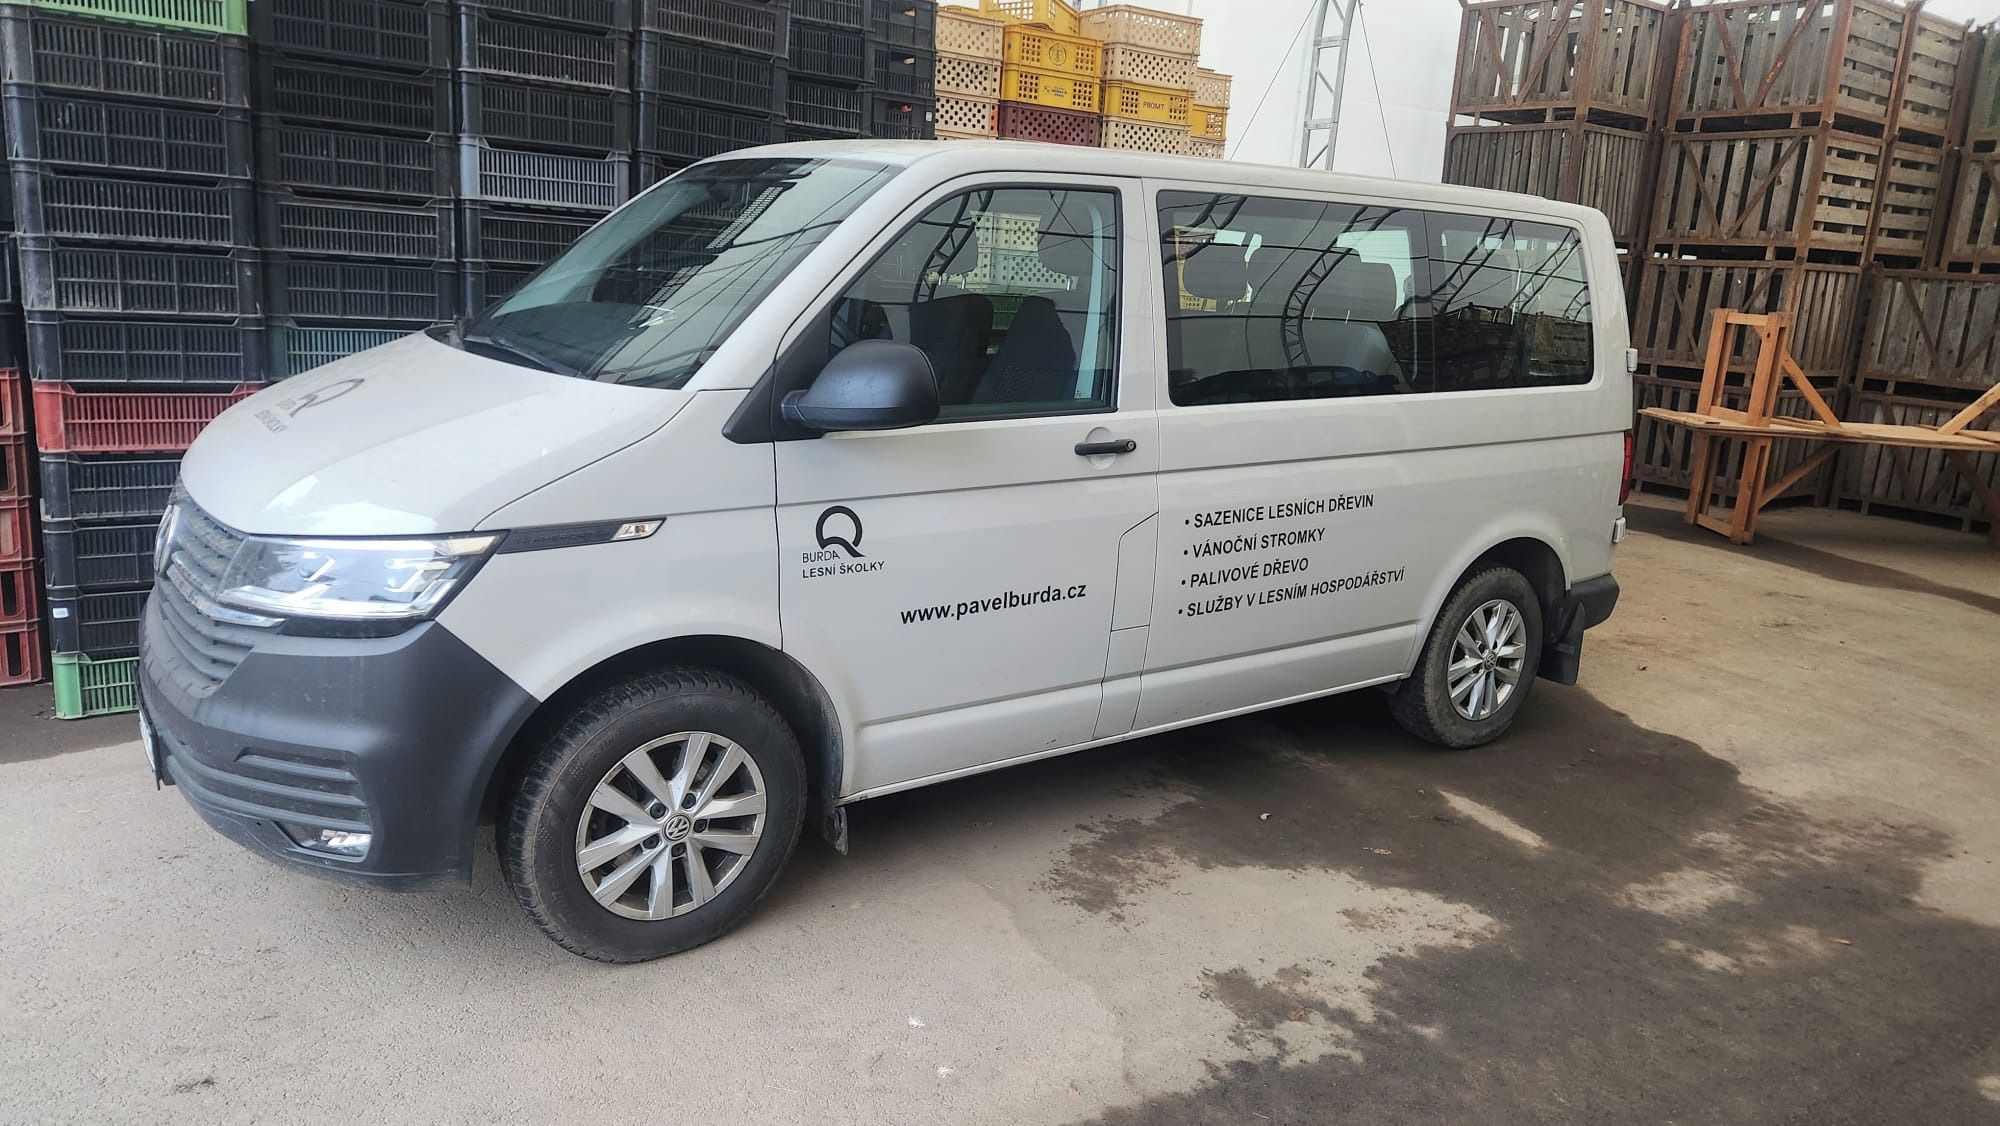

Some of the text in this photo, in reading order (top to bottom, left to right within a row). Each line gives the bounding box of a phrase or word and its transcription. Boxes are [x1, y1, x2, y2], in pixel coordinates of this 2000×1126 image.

[1193, 494, 1374, 528] SAZENICE LESNÍCH DŘEVIN
[801, 549, 841, 564] BURDA
[1192, 527, 1326, 559] VÁNOČNÍ STROMKY
[801, 560, 886, 579] LESNÍ ŠKOLKY
[1190, 557, 1309, 588] PALIVOVÉ DŘEVO
[900, 583, 1087, 625] www.pavelburda.cz
[1186, 565, 1406, 617] SLUŽBY V LESNÍM HOSPODÁŘSTVÍ
